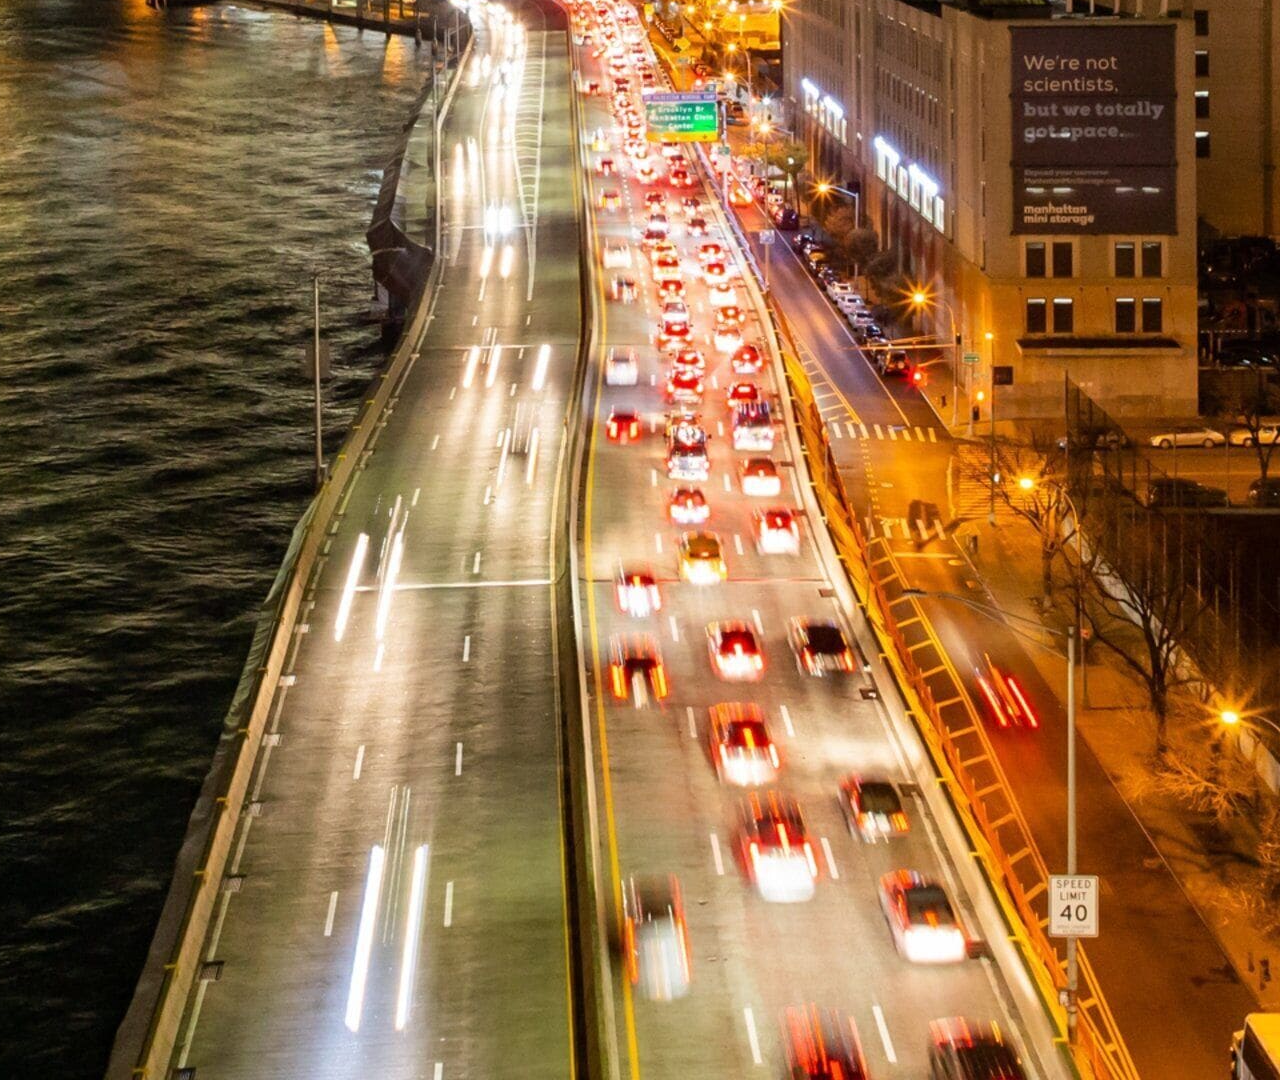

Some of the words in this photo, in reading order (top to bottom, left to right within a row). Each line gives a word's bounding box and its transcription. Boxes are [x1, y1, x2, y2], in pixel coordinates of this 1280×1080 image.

[1024, 55, 1080, 71] We're
[1086, 56, 1118, 70] not
[1024, 102, 1059, 117] but
[1062, 105, 1091, 117] we
[1095, 101, 1164, 120] totally
[1024, 124, 1058, 142] got
[1024, 201, 1087, 214] manhattan
[1024, 214, 1048, 223] mini
[1050, 214, 1095, 226] storage
[1056, 879, 1091, 889] SPEED
[1059, 891, 1087, 901] LIMIT
[1060, 904, 1088, 922] 40
